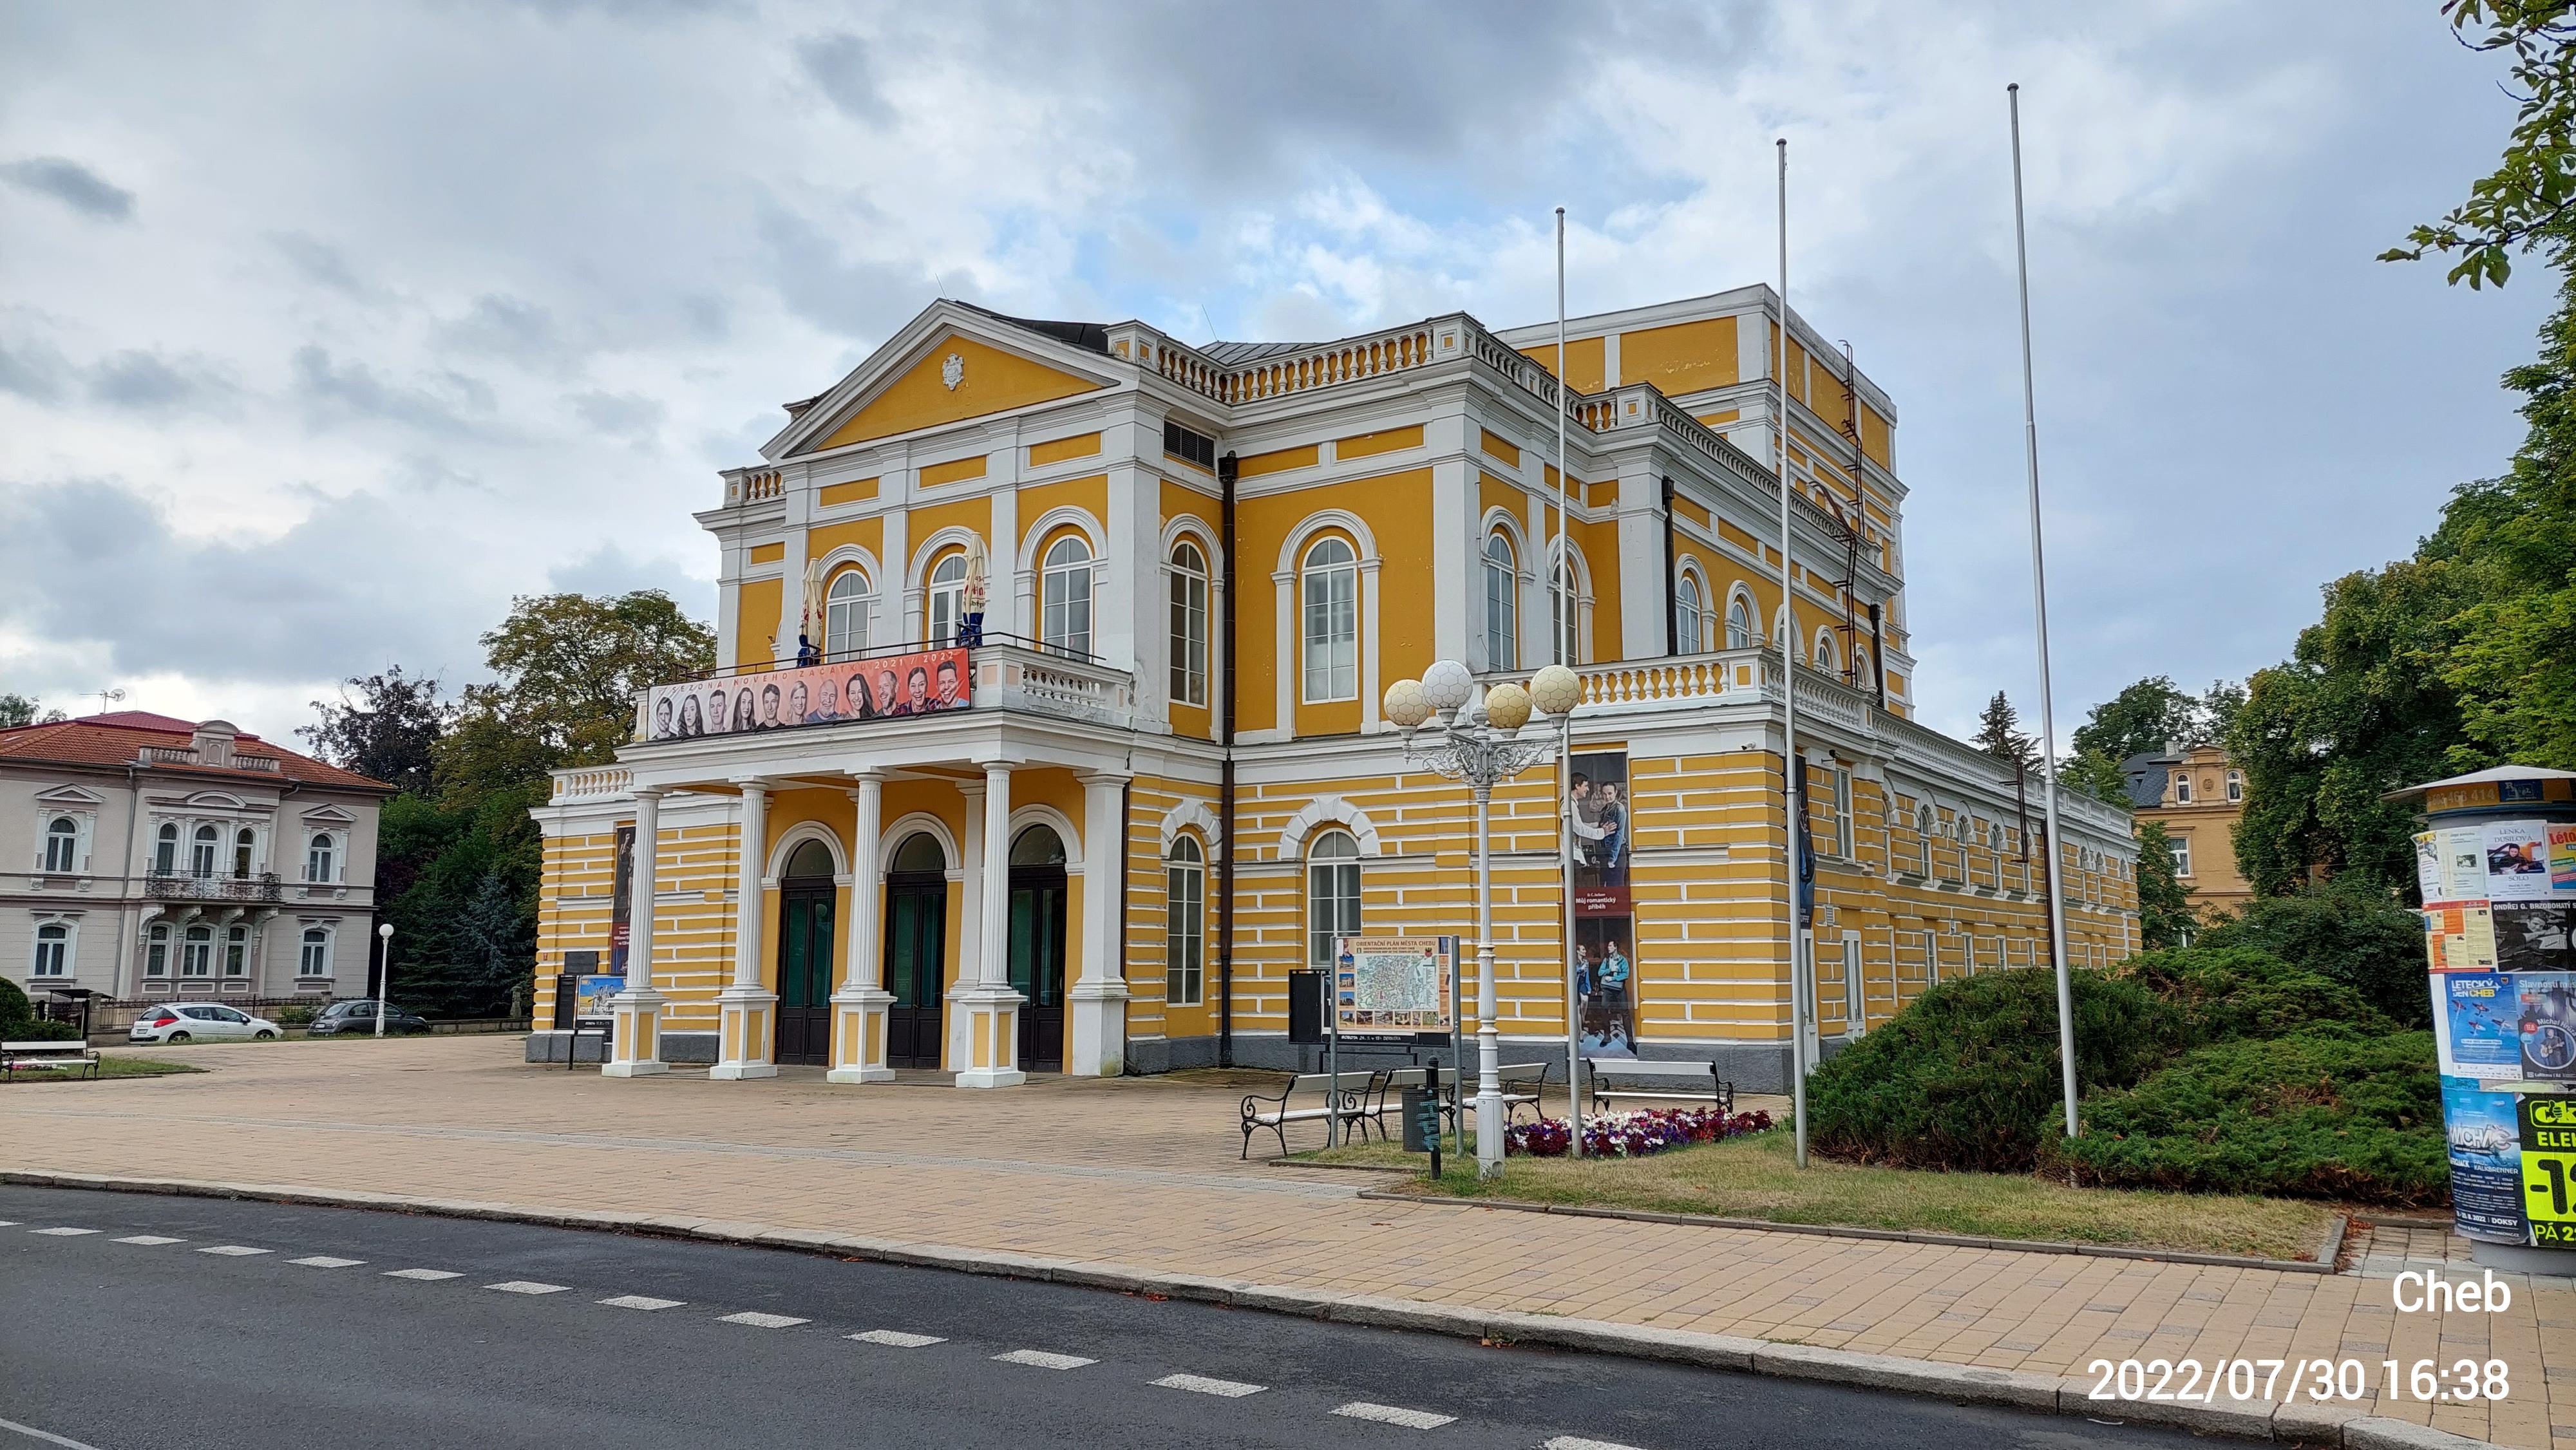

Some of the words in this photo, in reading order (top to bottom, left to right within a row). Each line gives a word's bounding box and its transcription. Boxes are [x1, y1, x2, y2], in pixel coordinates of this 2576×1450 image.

[875, 659, 902, 669] 2021
[923, 651, 954, 663] 2022
[2471, 788, 2496, 800] 414
[2530, 901, 2571, 910] BRZOBOHATÝ
[2451, 977, 2494, 989] LETECKÝ
[2519, 979, 2558, 988] Slavnosti
[2469, 989, 2496, 997] CHEB
[2474, 1164, 2519, 1174] KALKBRENNER
[2491, 1217, 2518, 1226] DOKSY
[2534, 1222, 2559, 1241] PÁ
